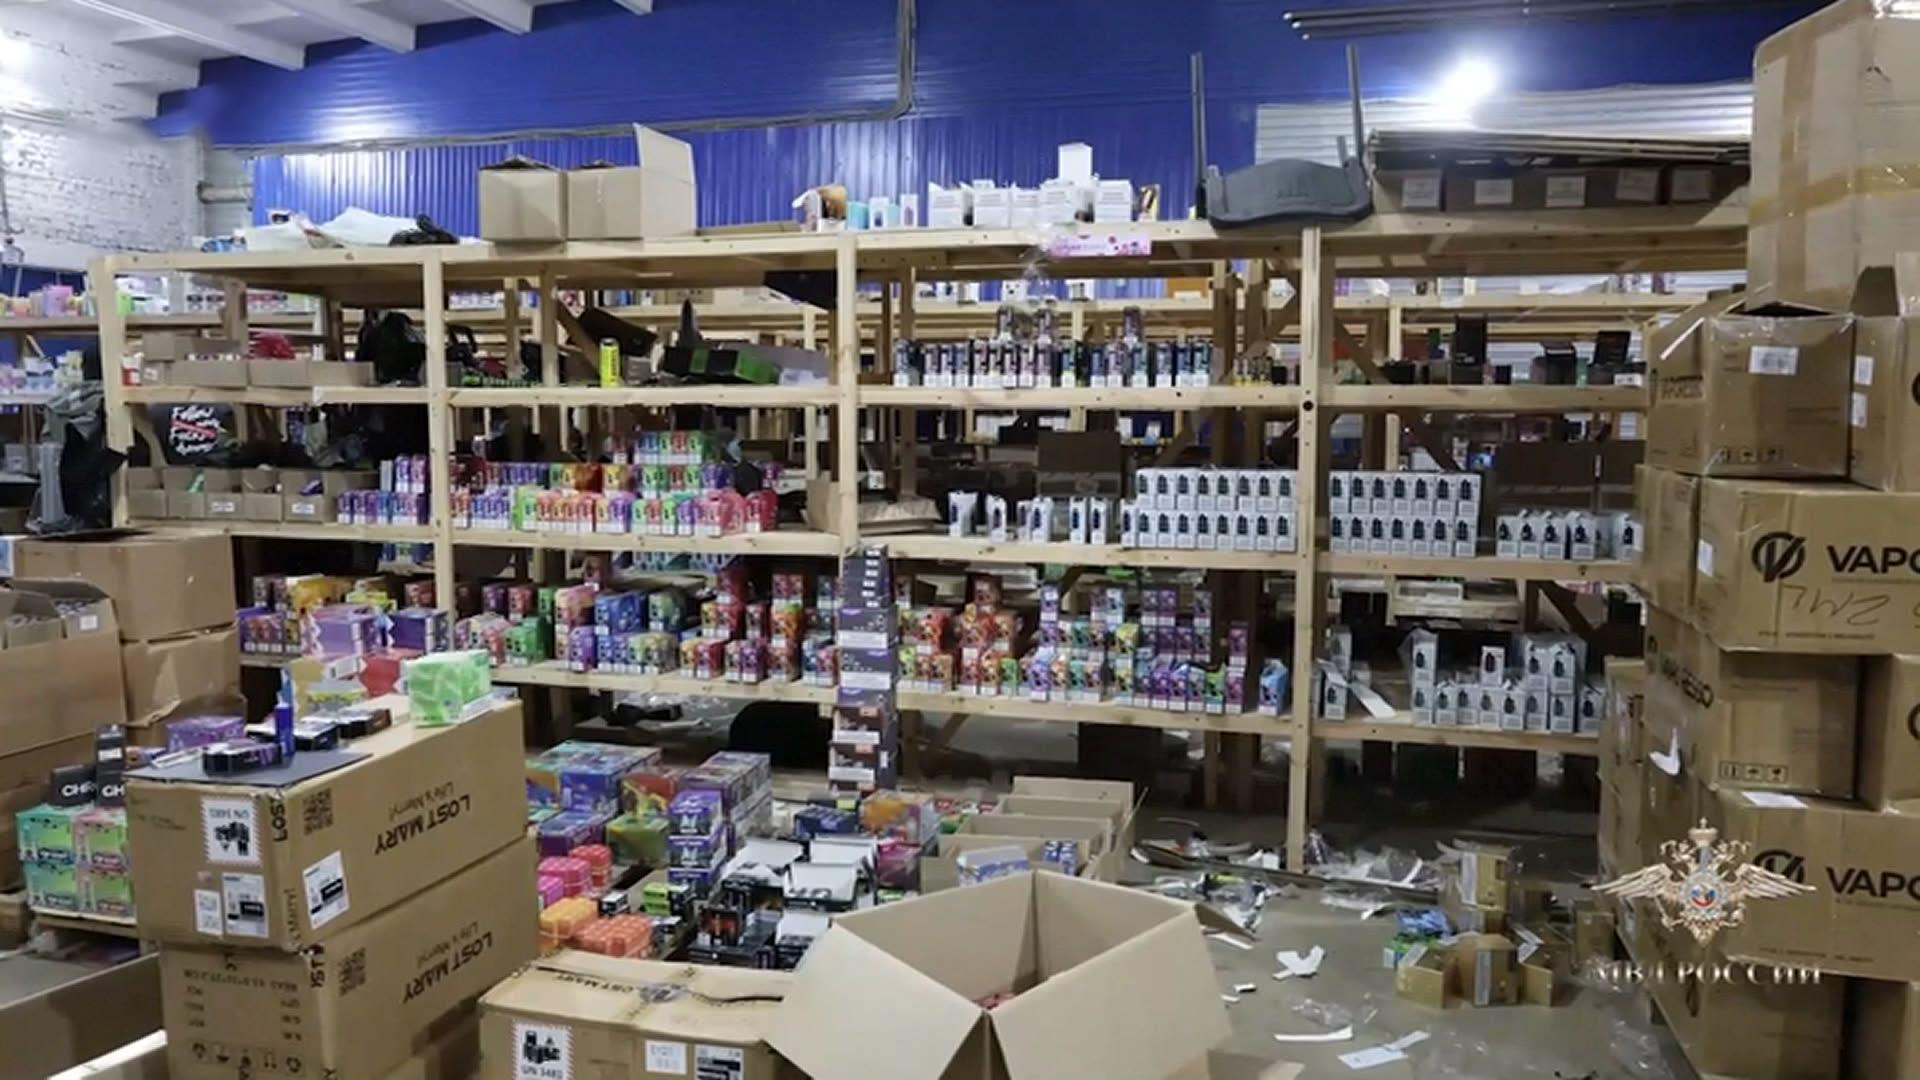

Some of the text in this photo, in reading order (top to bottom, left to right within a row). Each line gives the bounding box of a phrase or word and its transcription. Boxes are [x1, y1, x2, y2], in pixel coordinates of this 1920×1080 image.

[375, 793, 470, 856] LOST MARY
[402, 930, 493, 1005] LOST MARY
